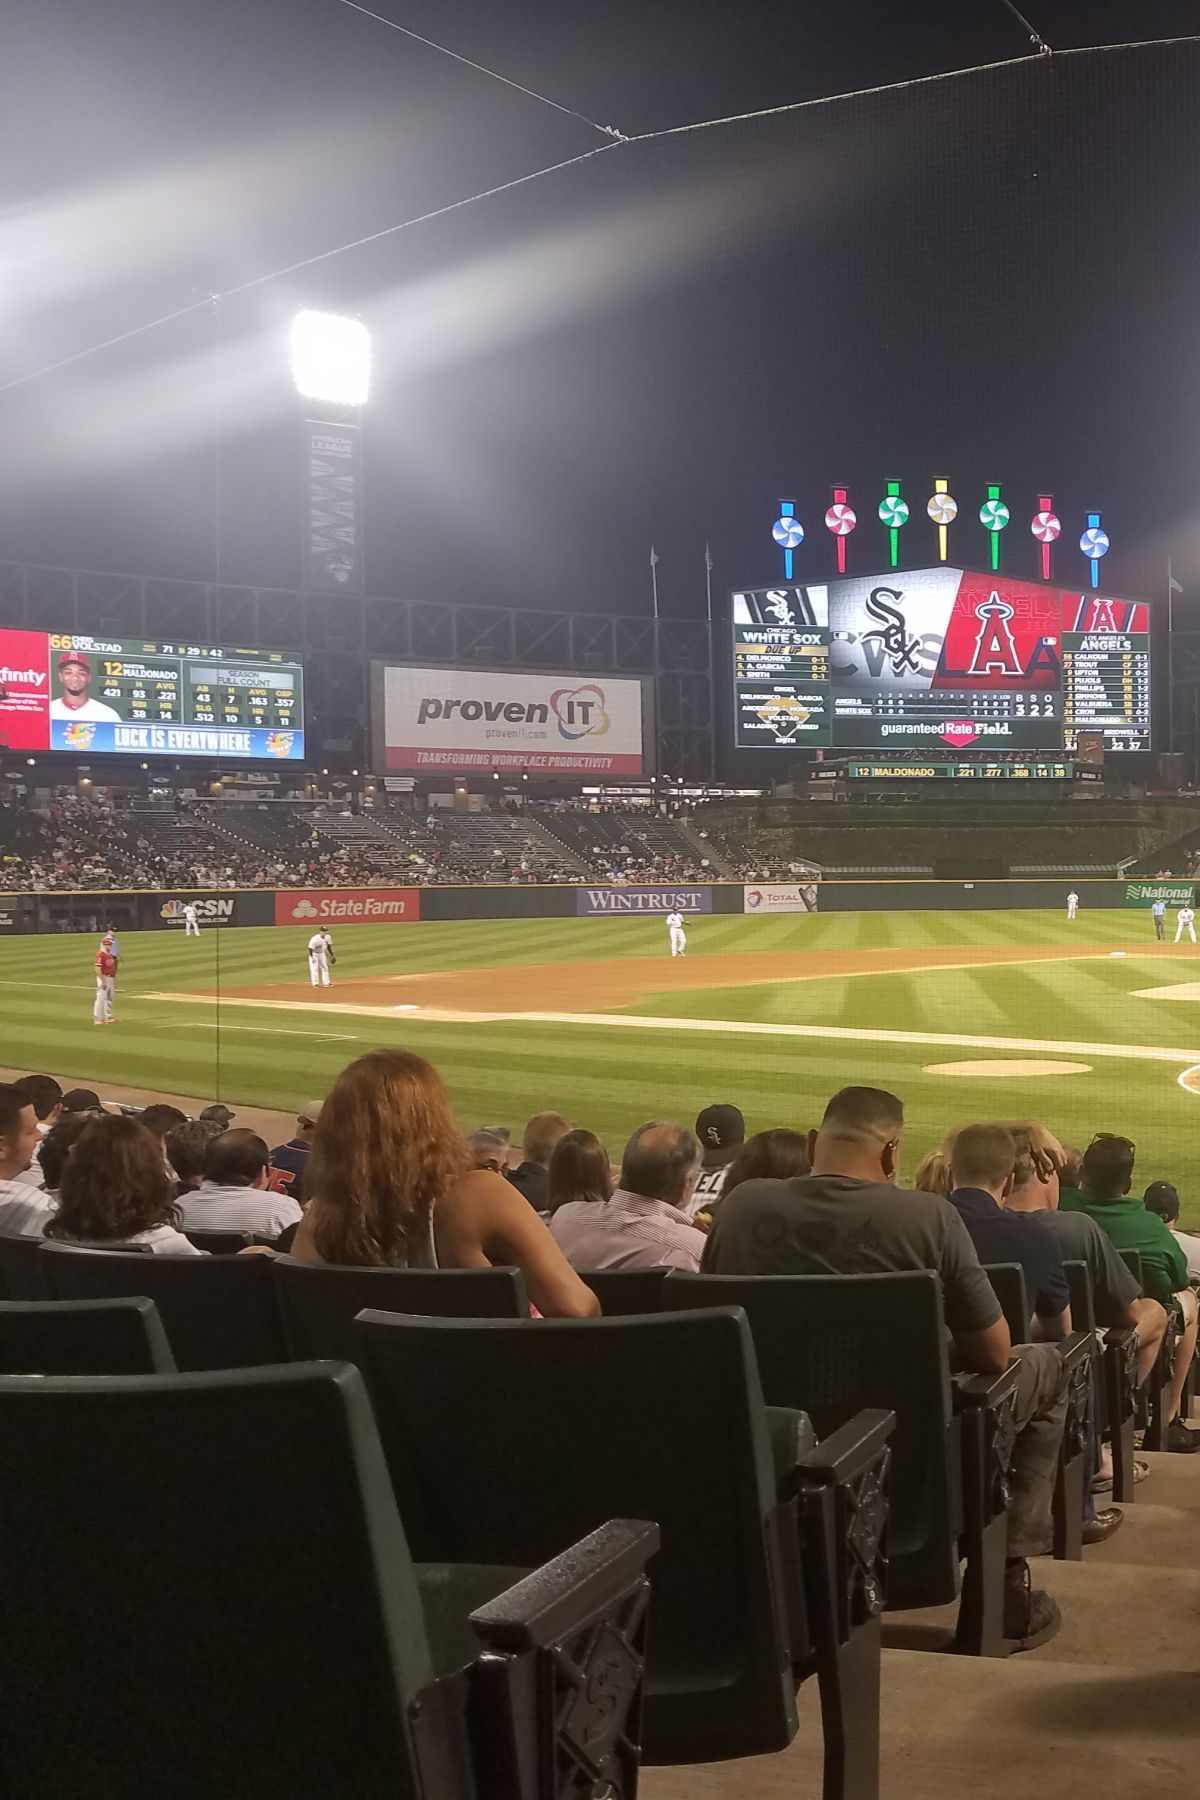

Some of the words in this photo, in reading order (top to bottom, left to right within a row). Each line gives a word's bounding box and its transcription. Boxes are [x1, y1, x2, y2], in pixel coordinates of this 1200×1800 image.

[742, 631, 790, 643] WHITE
[792, 634, 821, 645] SOX
[967, 590, 1024, 675] A
[50, 634, 73, 649] 66
[162, 644, 173, 653] 71
[187, 647, 200, 656] 29
[209, 649, 223, 657] 42
[72, 642, 122, 653] VOLSTAD
[765, 645, 785, 654] DUE
[788, 646, 802, 655] UP
[1080, 640, 1132, 651] ANGELS
[103, 661, 123, 676] 12
[123, 668, 178, 680] MALDONADO
[229, 670, 260, 678] SEASON
[156, 682, 175, 690] AVG
[217, 677, 238, 685] FULL
[240, 678, 271, 687] COUNT
[103, 688, 121, 697] 421
[132, 690, 146, 698] 93
[157, 691, 177, 700] .221
[248, 688, 267, 696] AVG
[196, 693, 211, 702] 43
[228, 695, 235, 704] 7
[1015, 694, 1024, 702] B
[1030, 694, 1037, 702] S
[1044, 694, 1053, 702] O
[159, 701, 173, 709] HR
[195, 704, 212, 712] SLG
[252, 707, 264, 715] HR
[1015, 704, 1026, 716] 3
[1030, 704, 1040, 716] 2
[1044, 704, 1054, 716] 2
[132, 709, 146, 718] 38
[159, 711, 172, 720] 14
[417, 697, 549, 725] proven
[567, 700, 595, 725] IT
[193, 713, 214, 722] .512
[225, 714, 238, 723] 10
[254, 716, 262, 724] 5
[280, 717, 289, 726] 11
[485, 728, 547, 740] provenit.com
[881, 722, 944, 736] guaranteed
[945, 722, 973, 735] Rate
[974, 722, 1013, 735] Field.
[114, 726, 148, 747] LUCK
[168, 729, 250, 751] EVERYWHERE
[1112, 741, 1124, 750] 22
[1128, 741, 1141, 750] 37
[417, 751, 490, 766] TRANSFORMING
[491, 754, 546, 767] WORKPLACE
[547, 756, 613, 769] PRODUCTIVITY
[858, 767, 870, 776] 12
[874, 767, 935, 776] MALDONADO
[957, 768, 975, 777] .221
[984, 768, 1002, 777] .277
[1010, 769, 1029, 777] .368
[1036, 769, 1048, 777] 14
[1054, 769, 1066, 777] 38
[767, 893, 799, 901] TOTAL
[1141, 886, 1194, 898] National
[586, 890, 702, 909] WINTRUST
[192, 899, 234, 916] CSN
